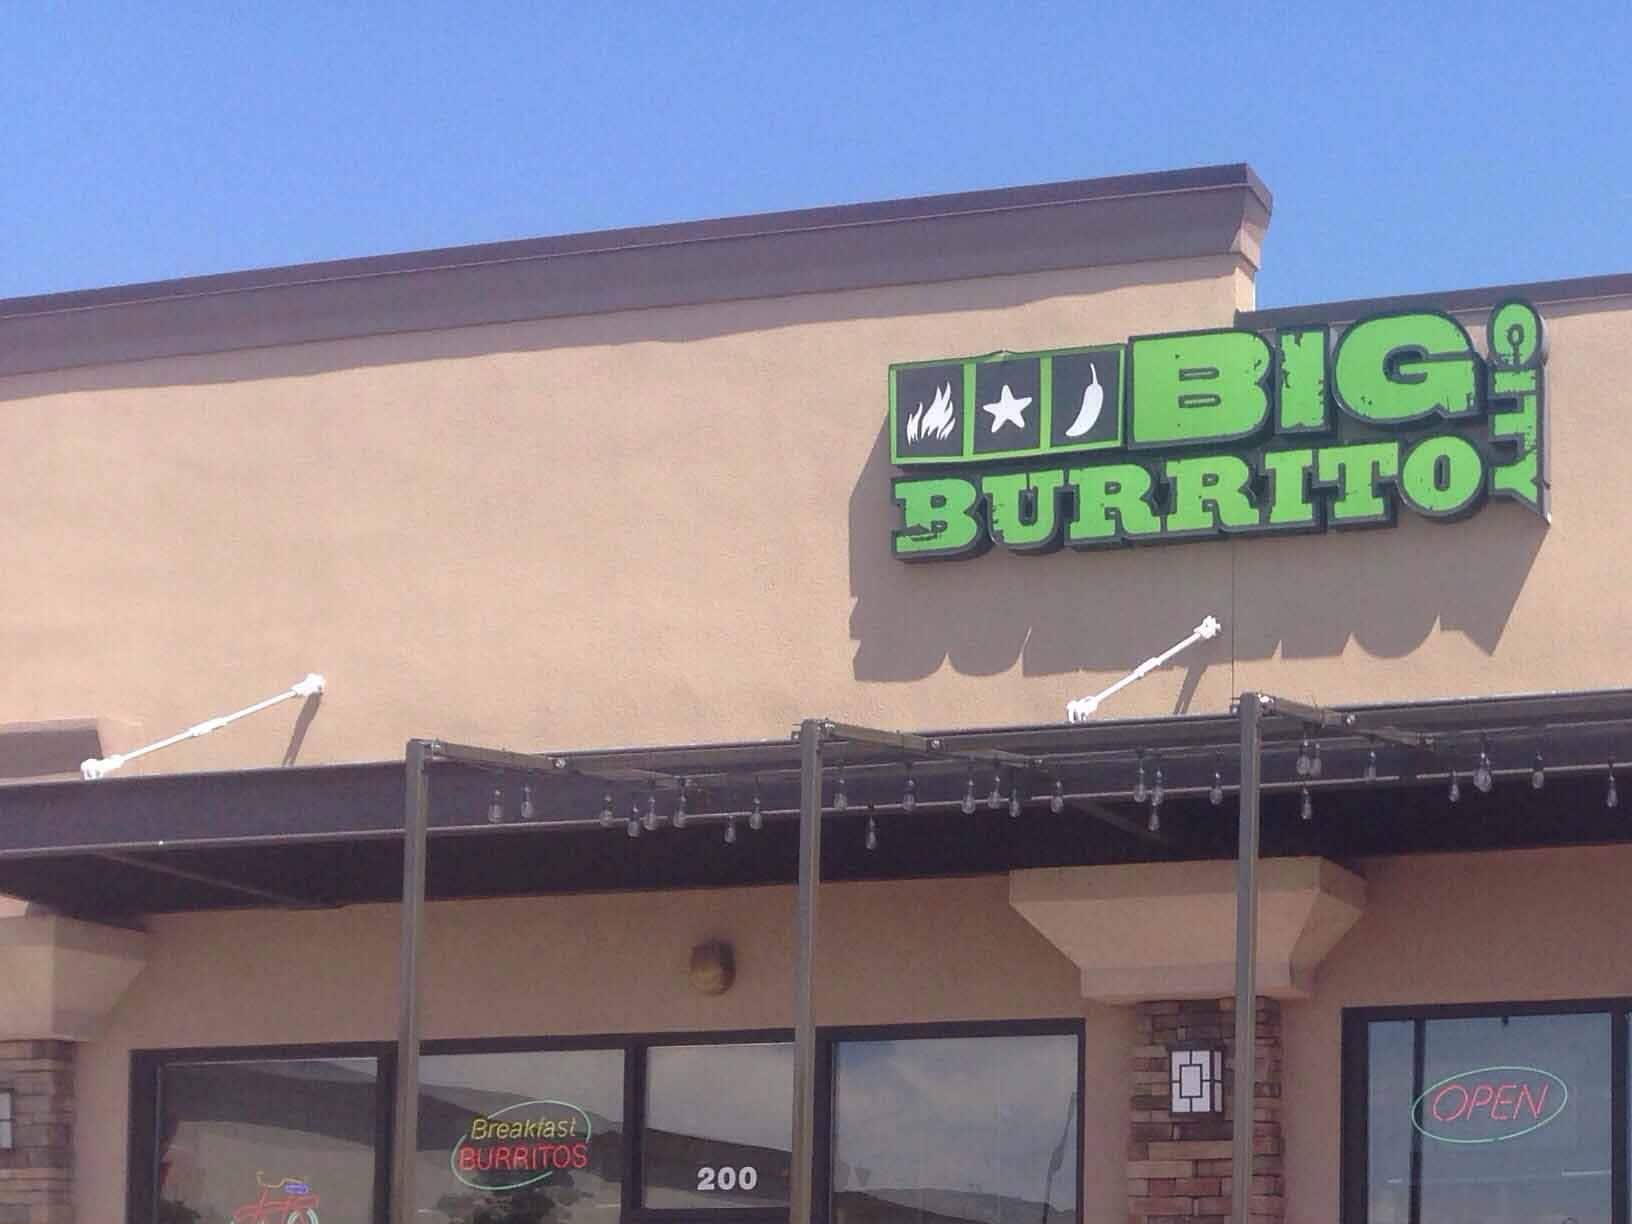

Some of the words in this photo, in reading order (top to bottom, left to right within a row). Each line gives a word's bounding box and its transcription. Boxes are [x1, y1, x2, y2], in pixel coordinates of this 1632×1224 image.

[1129, 311, 1485, 446] BIG
[1489, 301, 1543, 510] CITY
[892, 433, 1485, 556] BURRITO
[1431, 1082, 1550, 1122] OPEN
[471, 1117, 577, 1140] Breakfast
[459, 1143, 588, 1170] BURRITOS
[697, 1166, 758, 1190] 200
